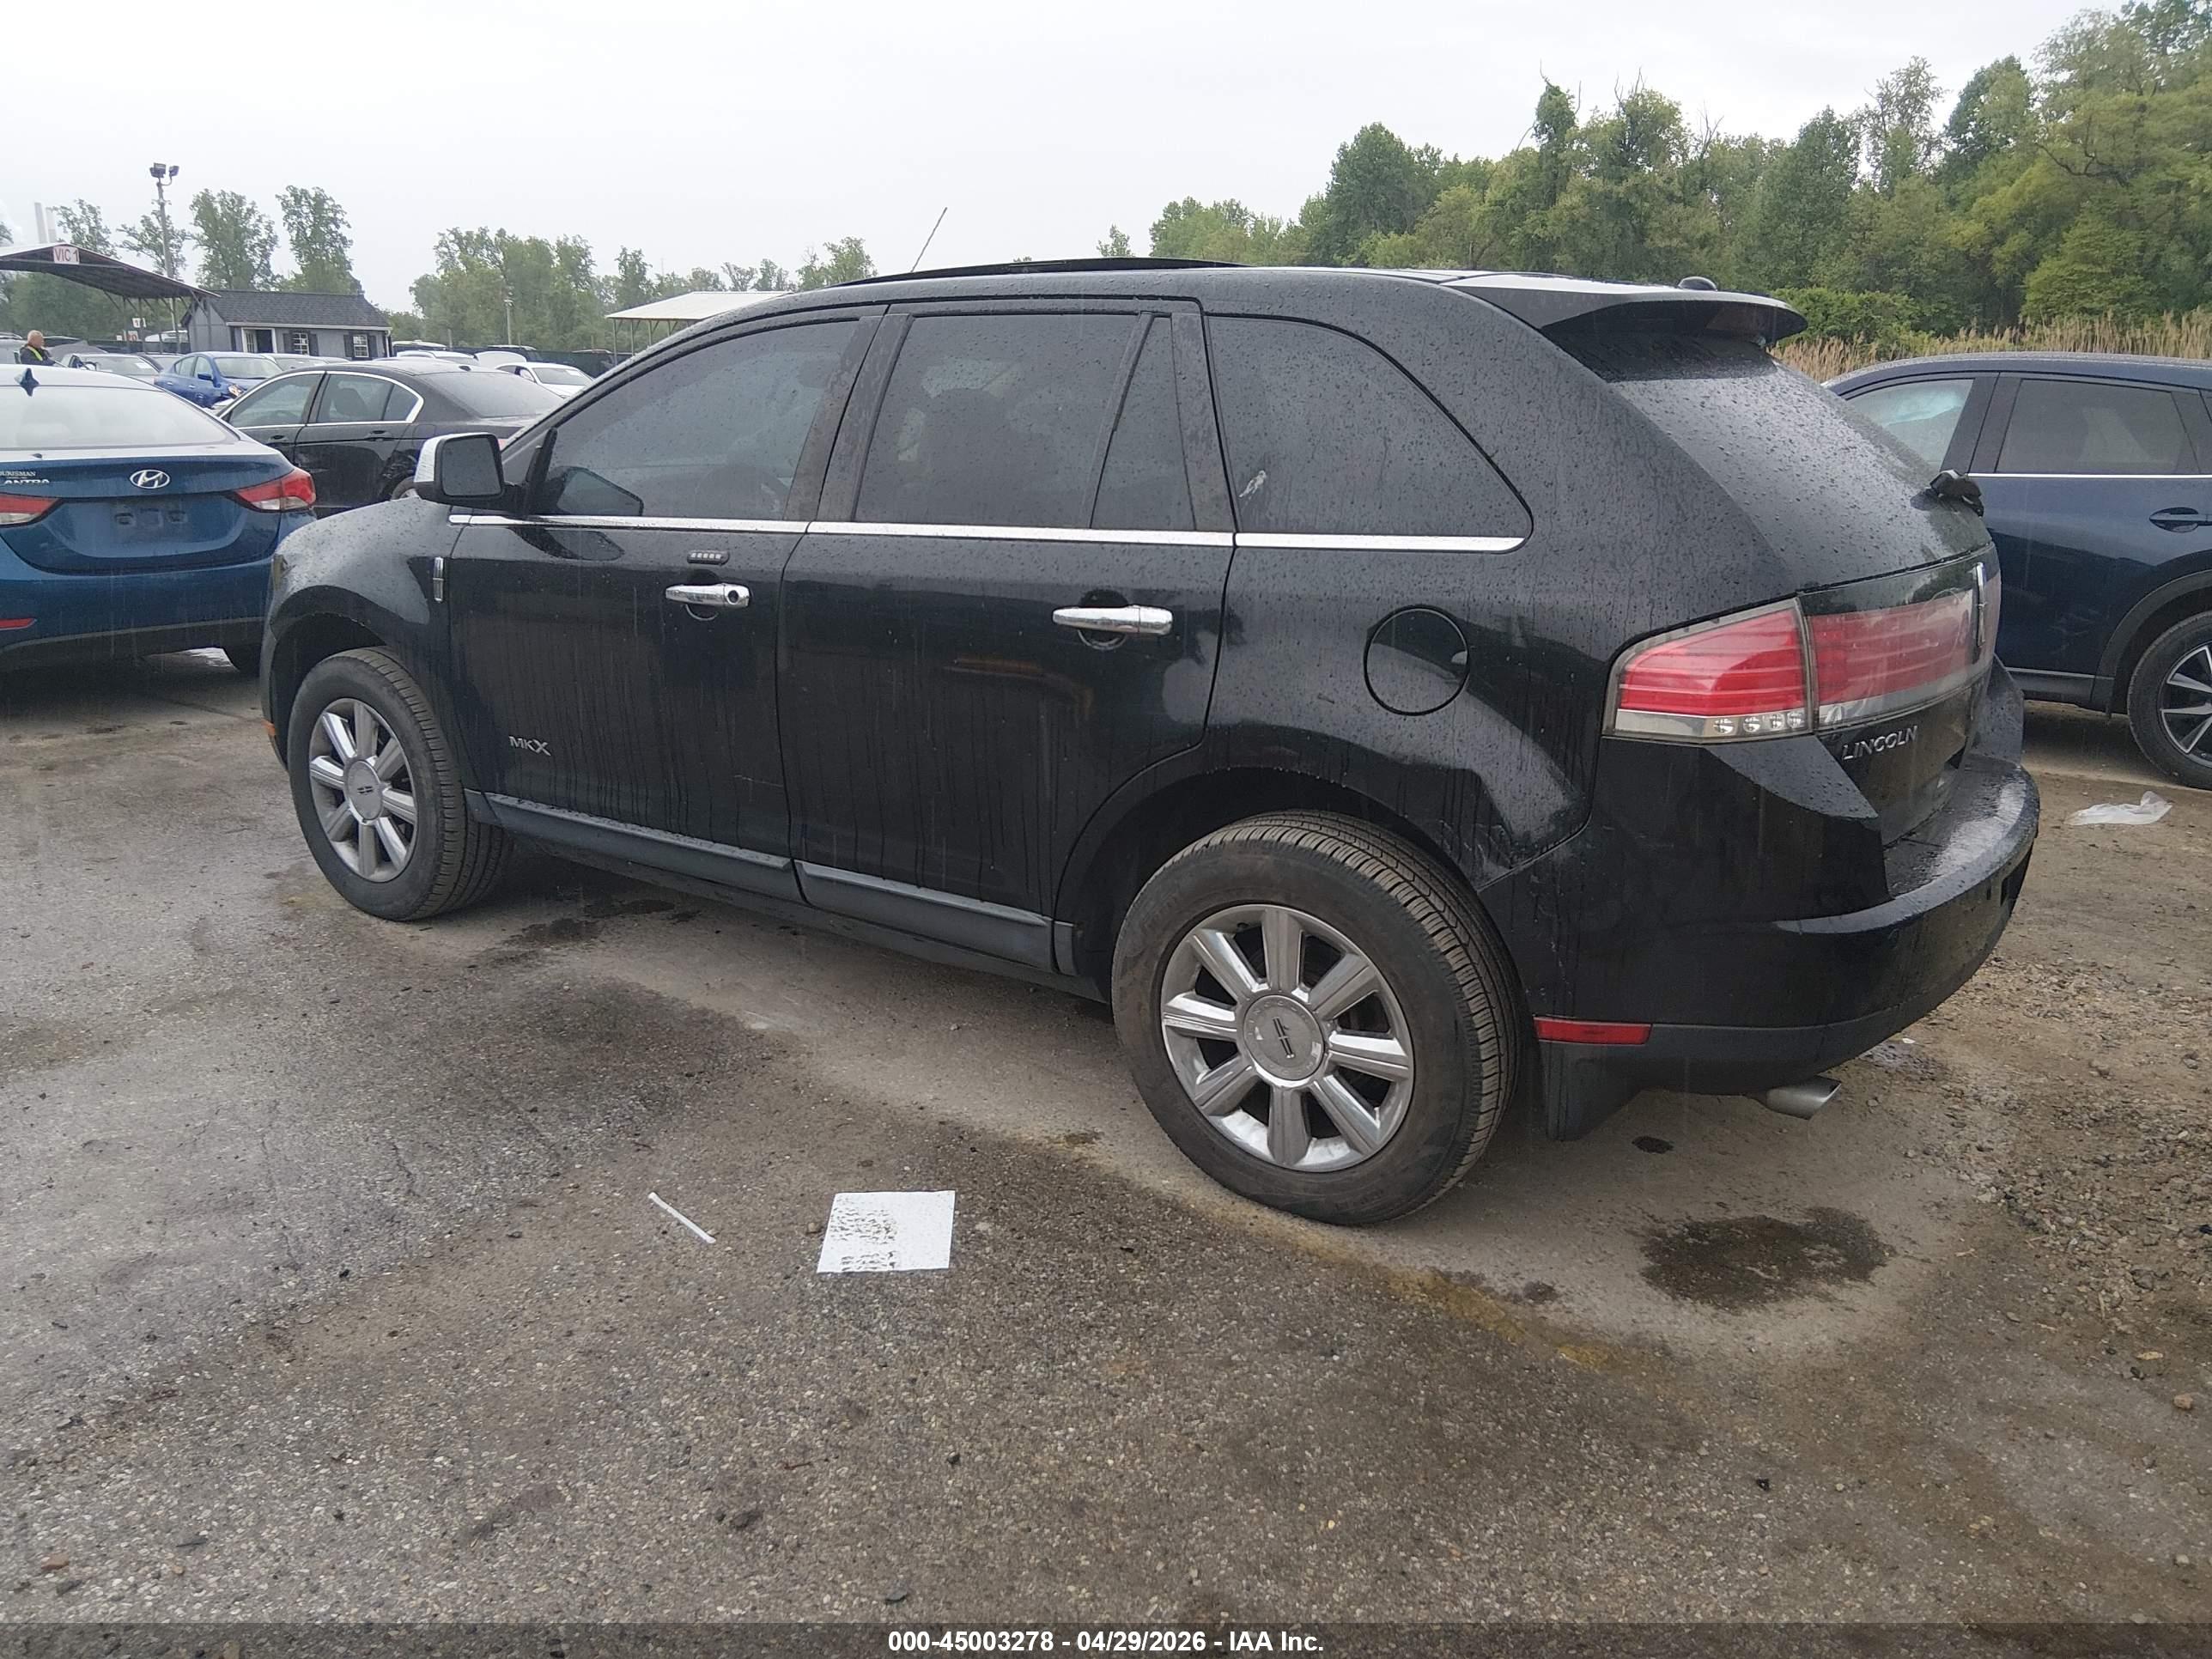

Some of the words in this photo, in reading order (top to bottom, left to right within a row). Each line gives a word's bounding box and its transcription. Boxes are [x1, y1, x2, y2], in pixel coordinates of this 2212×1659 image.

[54, 248, 70, 262] VIC
[72, 249, 78, 263] 1
[508, 735, 551, 757] MKX
[1842, 725, 1918, 761] LINCOLN
